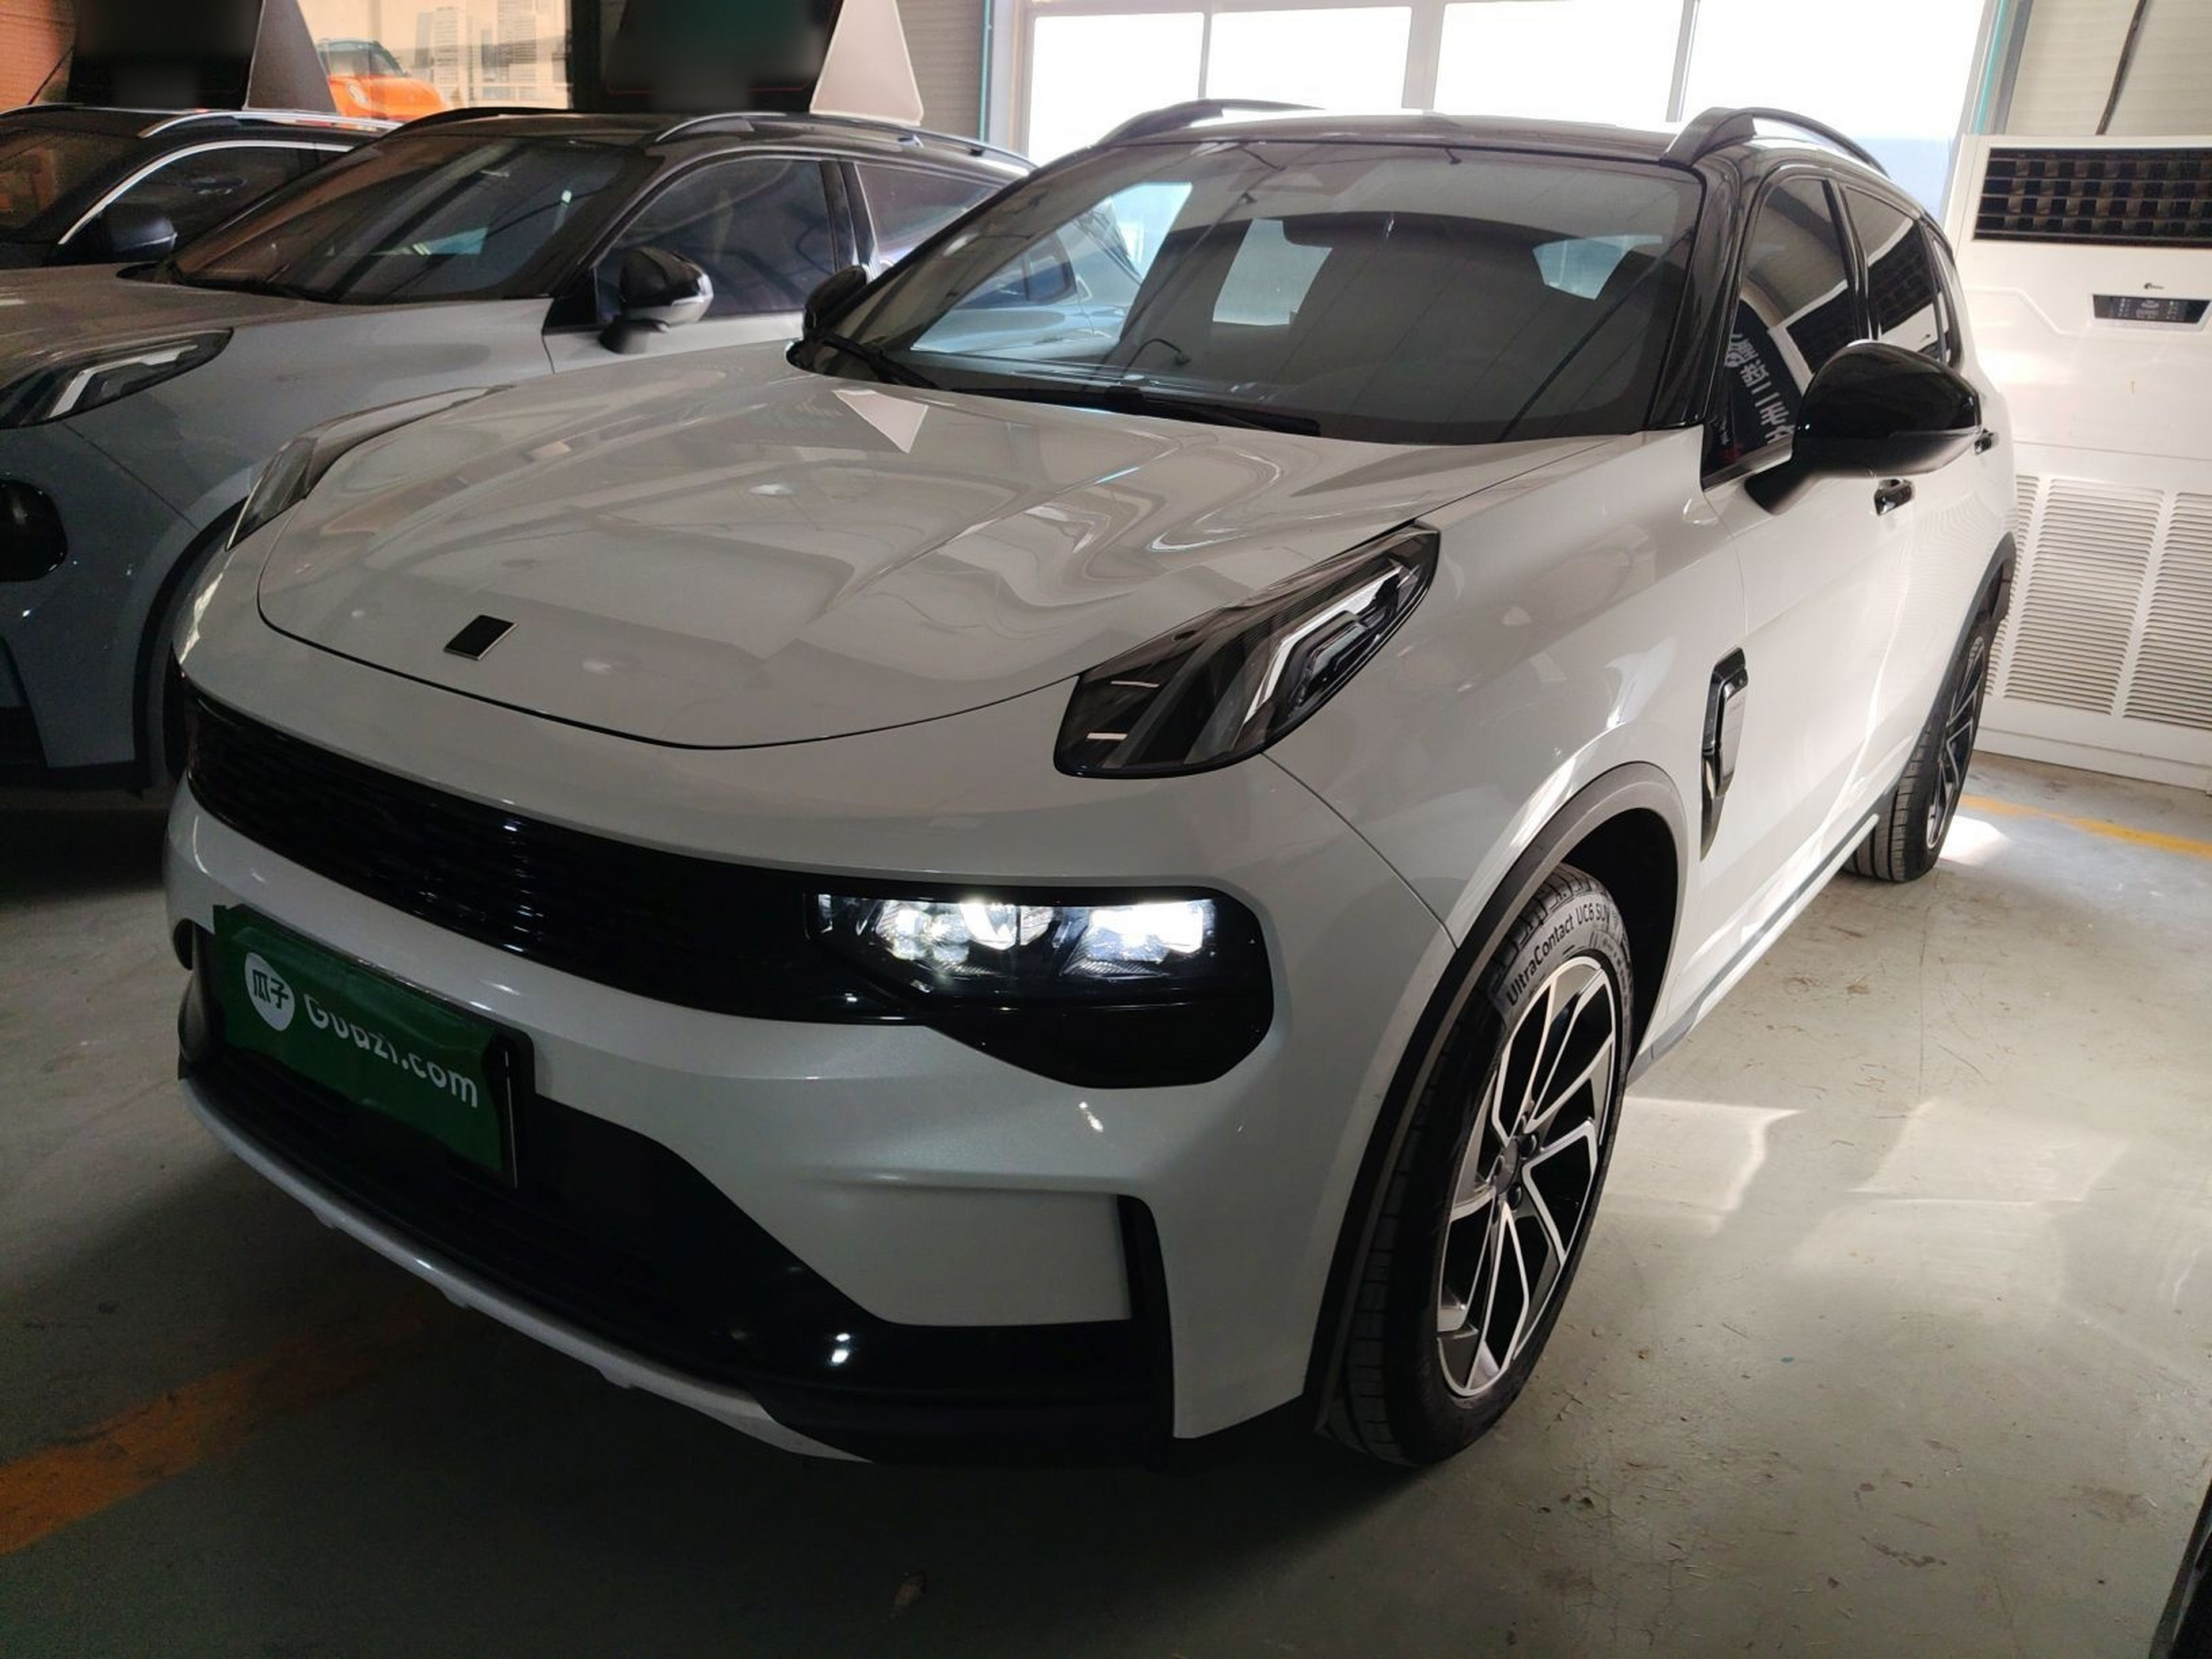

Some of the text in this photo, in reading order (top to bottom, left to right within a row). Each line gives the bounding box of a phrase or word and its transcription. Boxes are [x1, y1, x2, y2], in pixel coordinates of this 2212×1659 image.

[1506, 914, 1574, 1006] UltraContact
[1576, 902, 1594, 925] UC6
[252, 969, 478, 1108] 瓜子 Guazi.com
